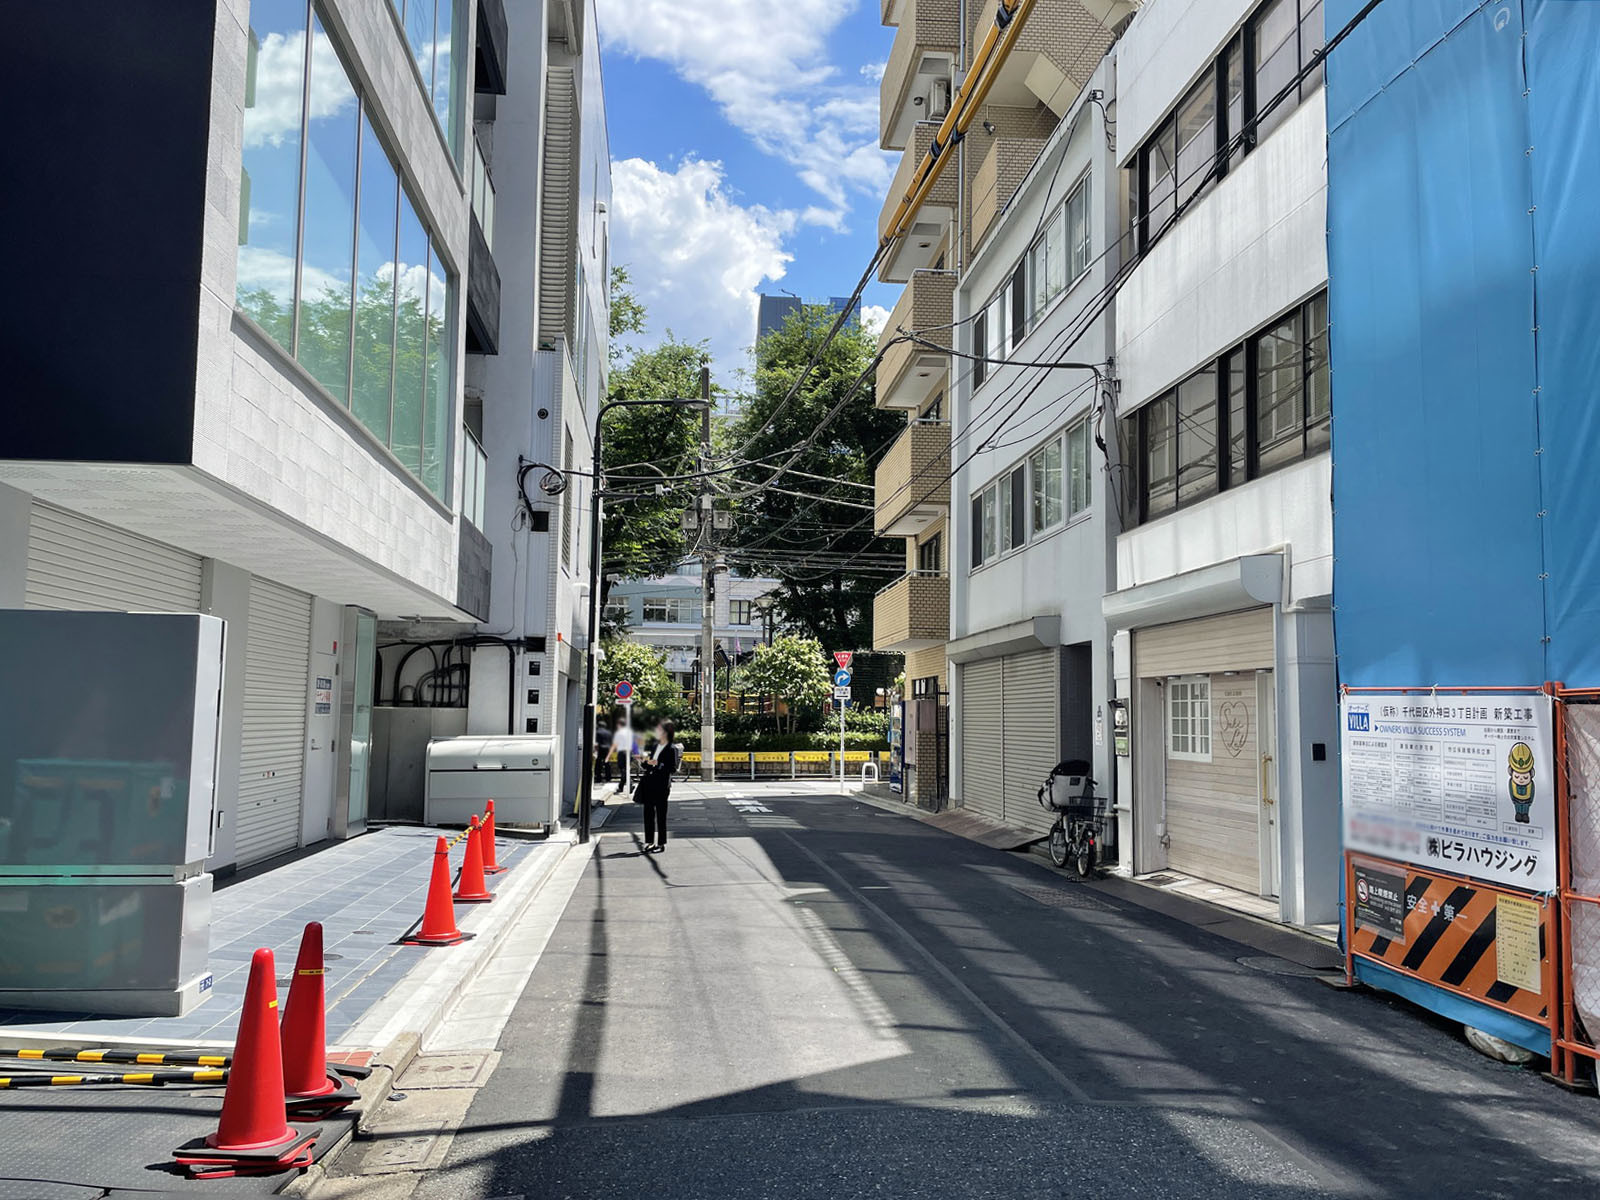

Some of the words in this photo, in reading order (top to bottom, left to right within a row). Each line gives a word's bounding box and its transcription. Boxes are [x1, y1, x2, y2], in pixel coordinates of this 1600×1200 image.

[1494, 707, 1533, 721] 新築工事
[1349, 714, 1369, 730] VILLA
[1379, 724, 1402, 735] OWNERS
[1402, 725, 1418, 735] VILLA
[1418, 726, 1443, 737] SUCCESS
[1443, 727, 1467, 737] SYSTEM
